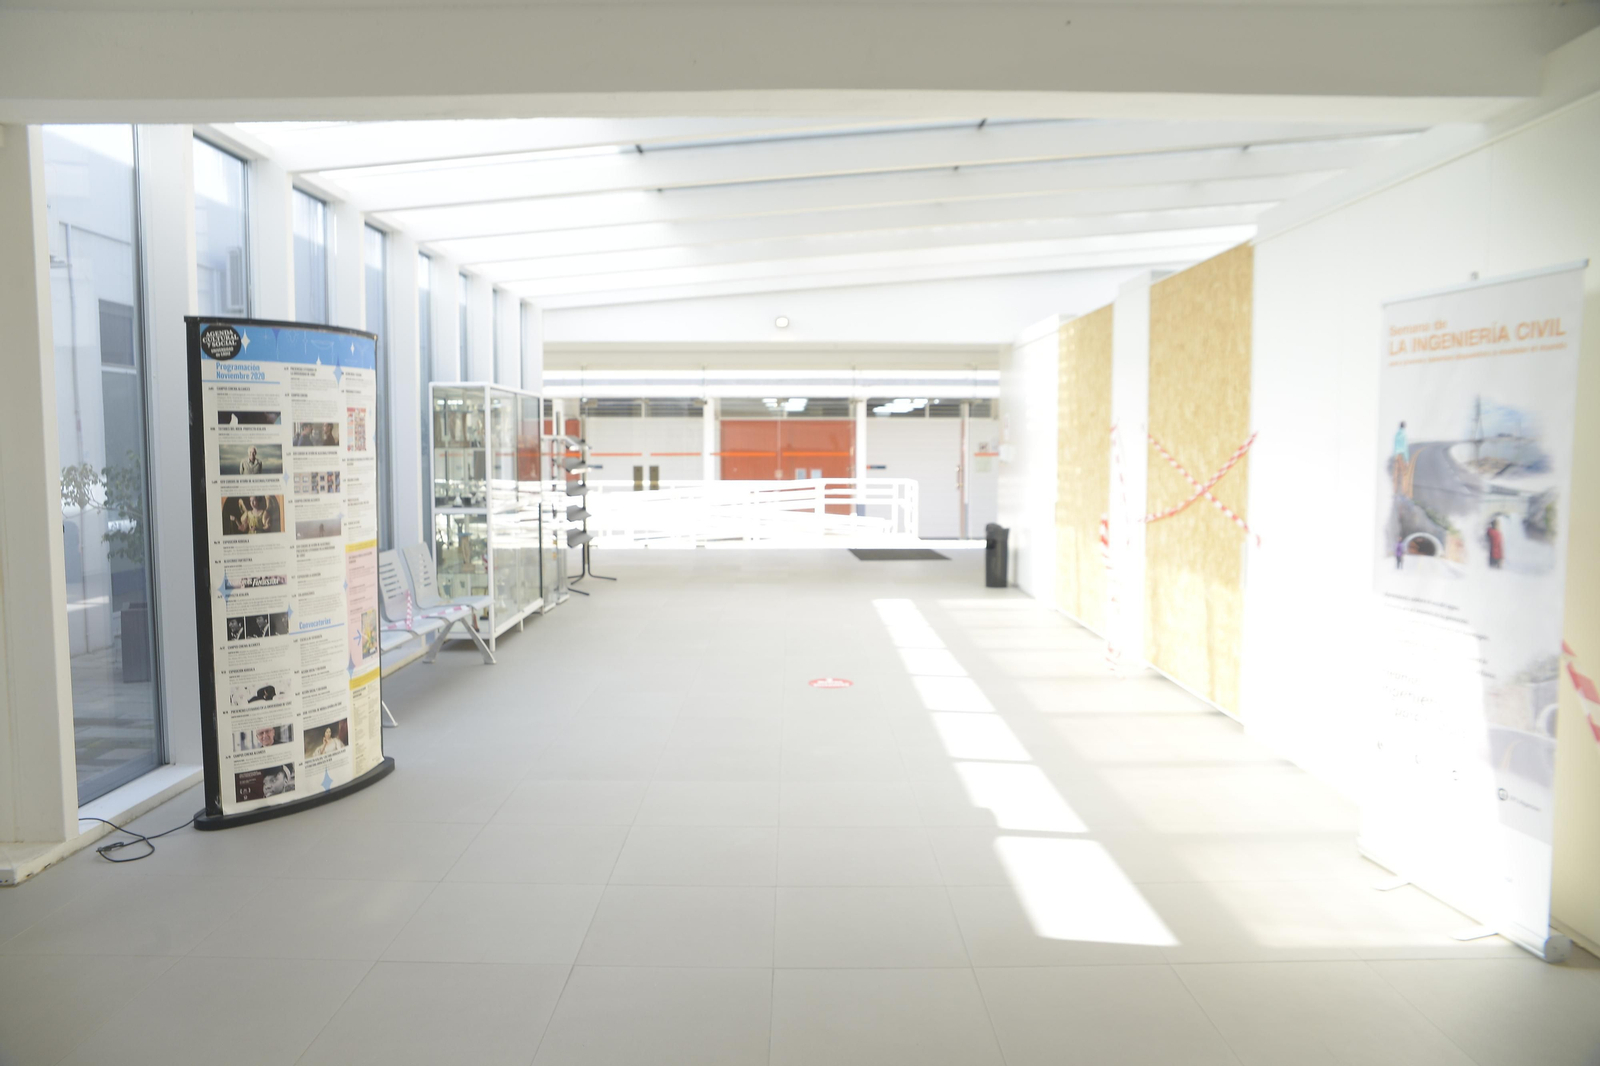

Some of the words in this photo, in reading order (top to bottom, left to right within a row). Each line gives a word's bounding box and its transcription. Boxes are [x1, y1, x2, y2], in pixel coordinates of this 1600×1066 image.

[202, 333, 239, 344] CULTURAL
[206, 329, 233, 338] AGENDA
[1388, 338, 1408, 356] LA
[1412, 322, 1510, 352] INGENIERÍA
[1515, 317, 1567, 341] CIVIL
[212, 339, 237, 348] SOCIAL
[216, 361, 261, 372] Programación
[216, 371, 250, 380] Noviembre
[250, 371, 266, 381] 2020
